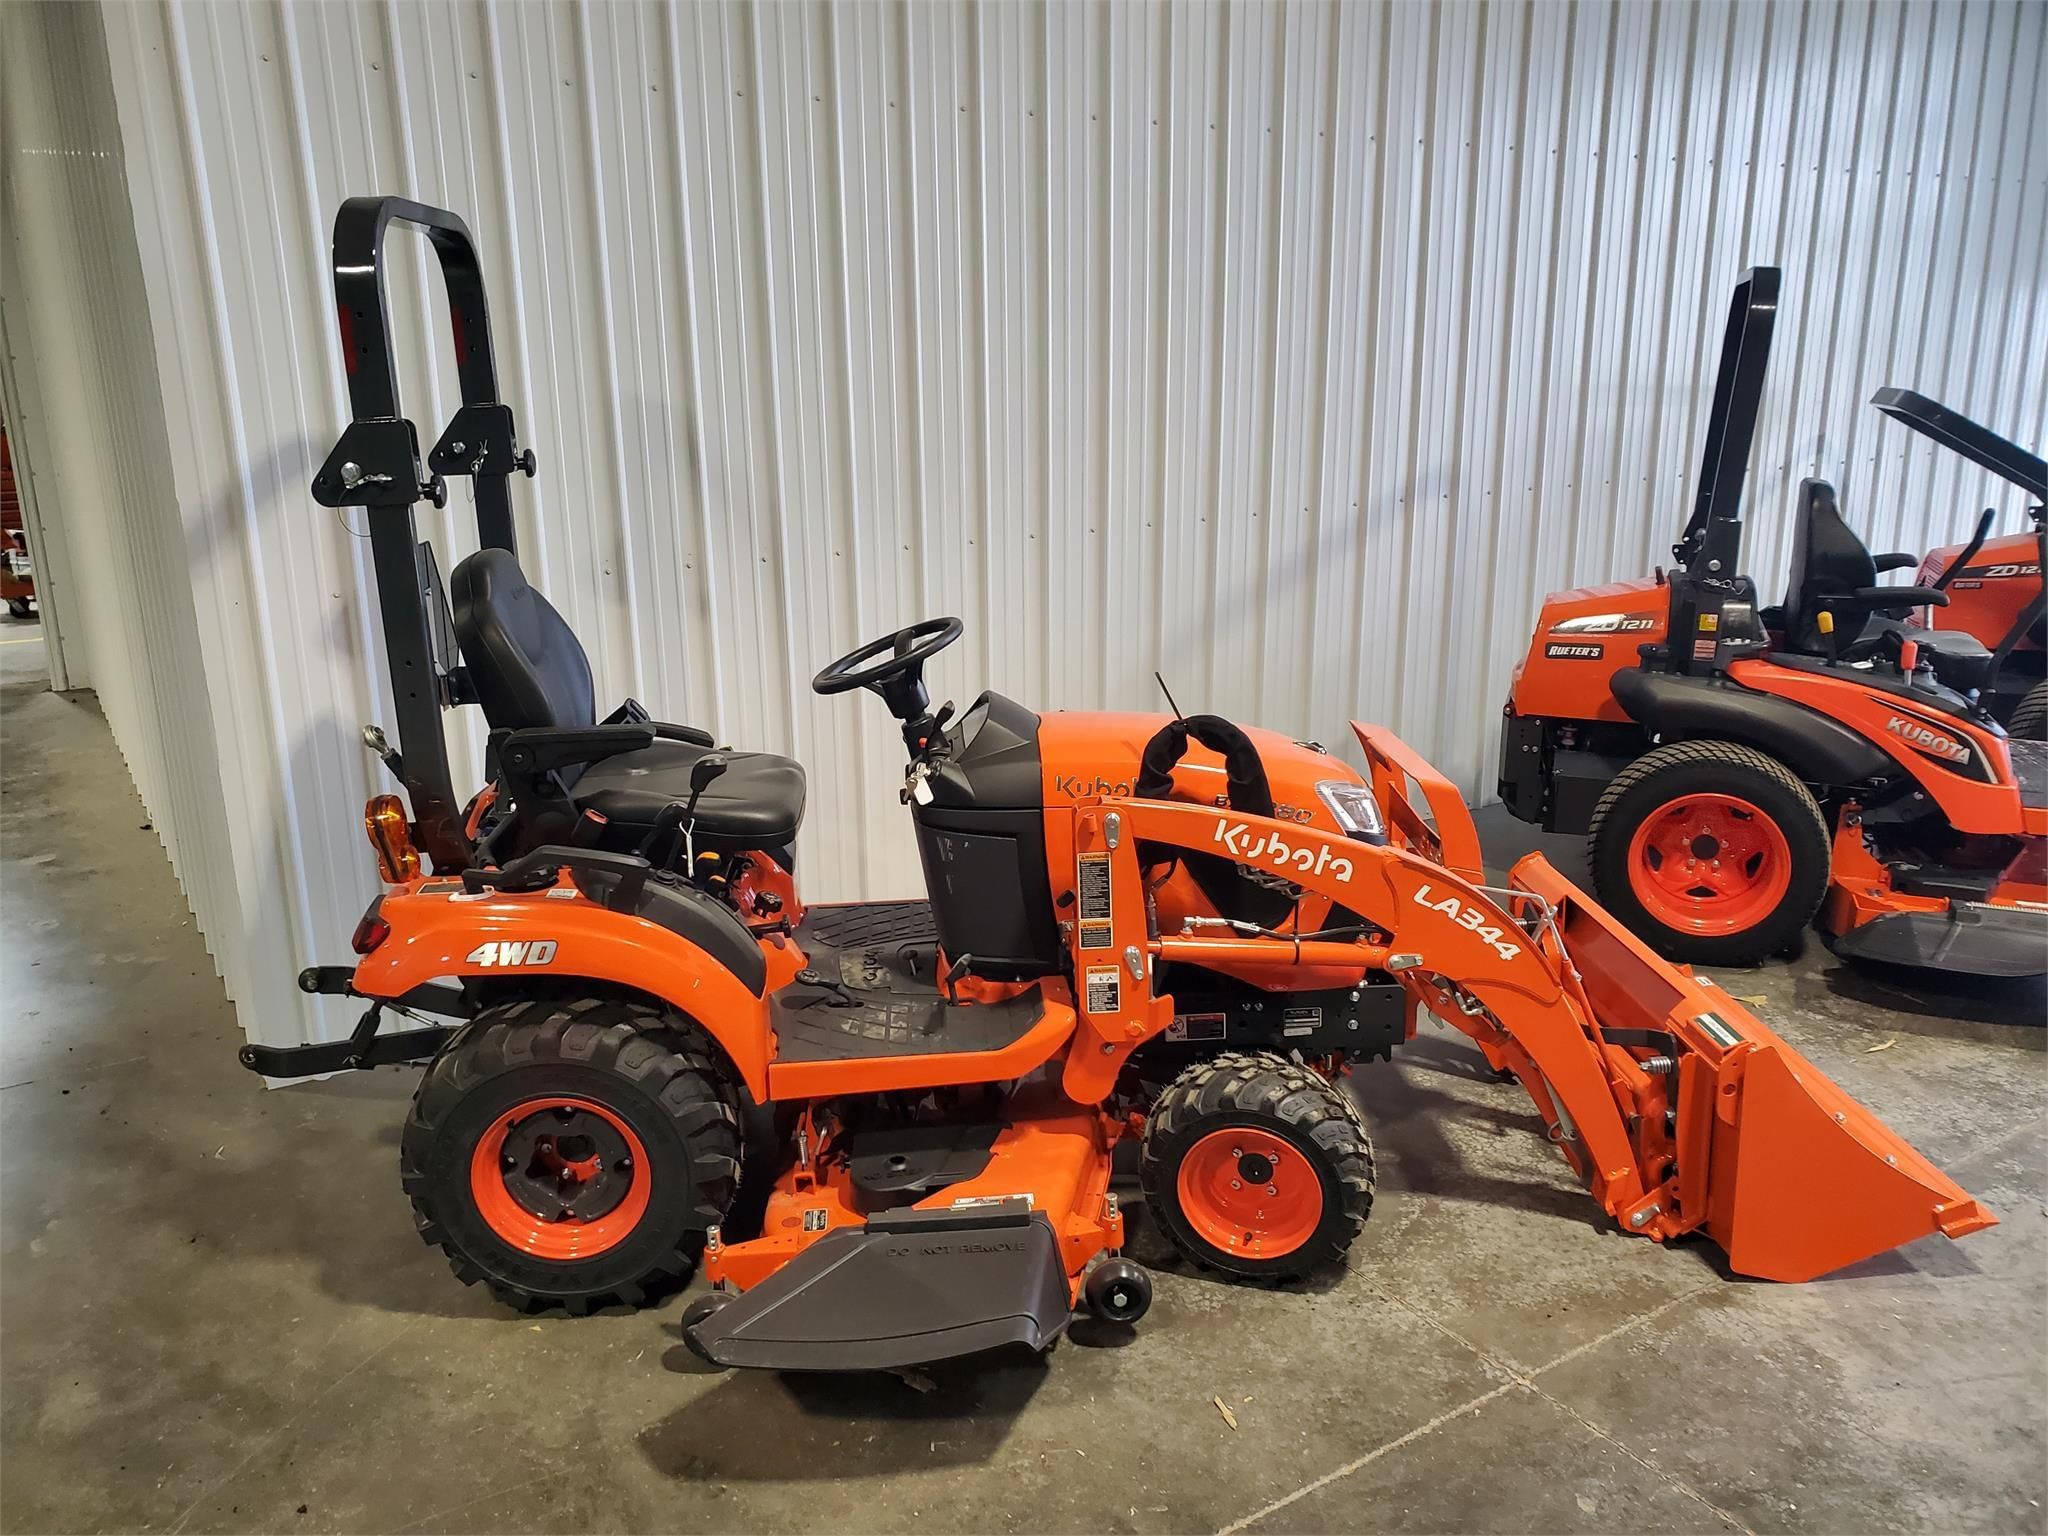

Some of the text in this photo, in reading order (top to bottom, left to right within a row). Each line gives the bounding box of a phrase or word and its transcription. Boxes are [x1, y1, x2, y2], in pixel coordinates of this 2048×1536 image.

[1548, 645, 1601, 658] RUETER'S
[1887, 716, 1971, 765] KUBOTA
[1214, 818, 1354, 883] Kubota
[1413, 885, 1521, 960] LA344
[466, 940, 558, 967] 4WD
[887, 1241, 1025, 1257] DO NOT REMOVE
